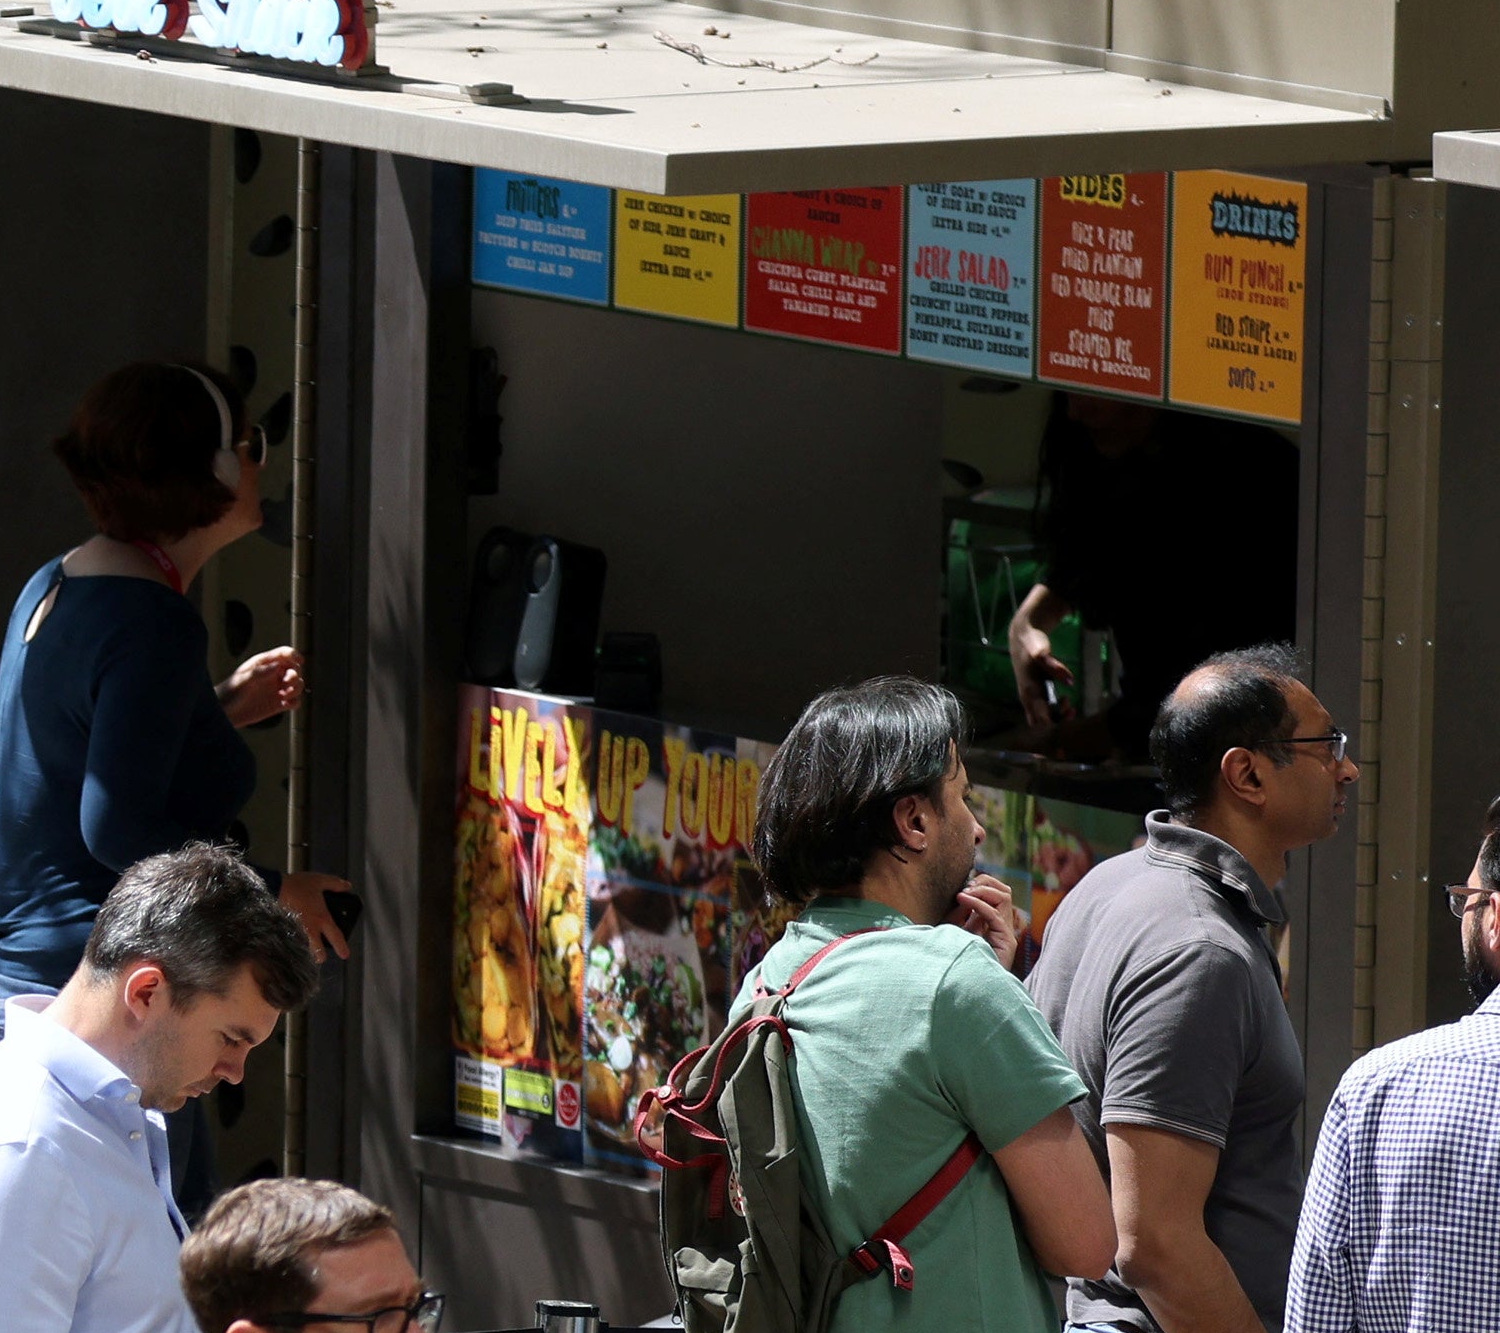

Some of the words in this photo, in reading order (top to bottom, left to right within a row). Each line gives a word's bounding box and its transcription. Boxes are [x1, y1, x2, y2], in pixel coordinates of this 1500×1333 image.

[833, 191, 868, 209] CHOICE
[871, 198, 882, 211] OF
[951, 184, 976, 200] GOAT
[991, 191, 1026, 208] CHOICE
[1062, 174, 1123, 203] SIDES
[647, 201, 685, 218] CHICKEN
[699, 208, 731, 225] CHOICE
[926, 194, 938, 207] OF
[941, 197, 962, 211] SIDE
[965, 201, 985, 215] AND
[987, 205, 1018, 220] SAUCE
[1212, 199, 1297, 241] DRINKS
[629, 218, 641, 230] OF
[689, 227, 717, 244] GRAVY
[967, 221, 988, 236] SIDE
[1107, 227, 1135, 253] PEAS
[663, 244, 691, 259] SAUCE
[751, 226, 815, 267] CHANNA
[820, 235, 865, 276] WRAP
[672, 264, 692, 279] SIDE
[914, 244, 952, 281] JERK
[958, 249, 1010, 291] SALAD
[1204, 251, 1234, 284] RUM
[1238, 257, 1286, 294] PUNCH
[856, 293, 878, 309] AND
[909, 294, 951, 312] CRUNCHY
[930, 281, 966, 297] GRILLED
[969, 287, 1010, 306] CHICKEN,
[1050, 272, 1071, 298] RED
[1073, 276, 1121, 309] CABBAGE
[1123, 283, 1153, 309] SLAW
[832, 306, 863, 324] SAUCE
[1214, 311, 1235, 337] RED
[909, 327, 939, 345] HONEY
[942, 333, 985, 352] MUSTARD
[987, 341, 1029, 359] DRESSING
[967, 322, 1011, 339] SULTANAS
[1068, 328, 1112, 359] STEAMED
[1114, 336, 1133, 365] VEG
[1206, 337, 1260, 356] (JAMAICAN
[1263, 344, 1297, 363] LAGER)
[1101, 361, 1151, 382] BROCCOLI)
[1228, 365, 1257, 390] SOFTS
[596, 729, 651, 839] UP
[662, 735, 762, 850] YOUR
